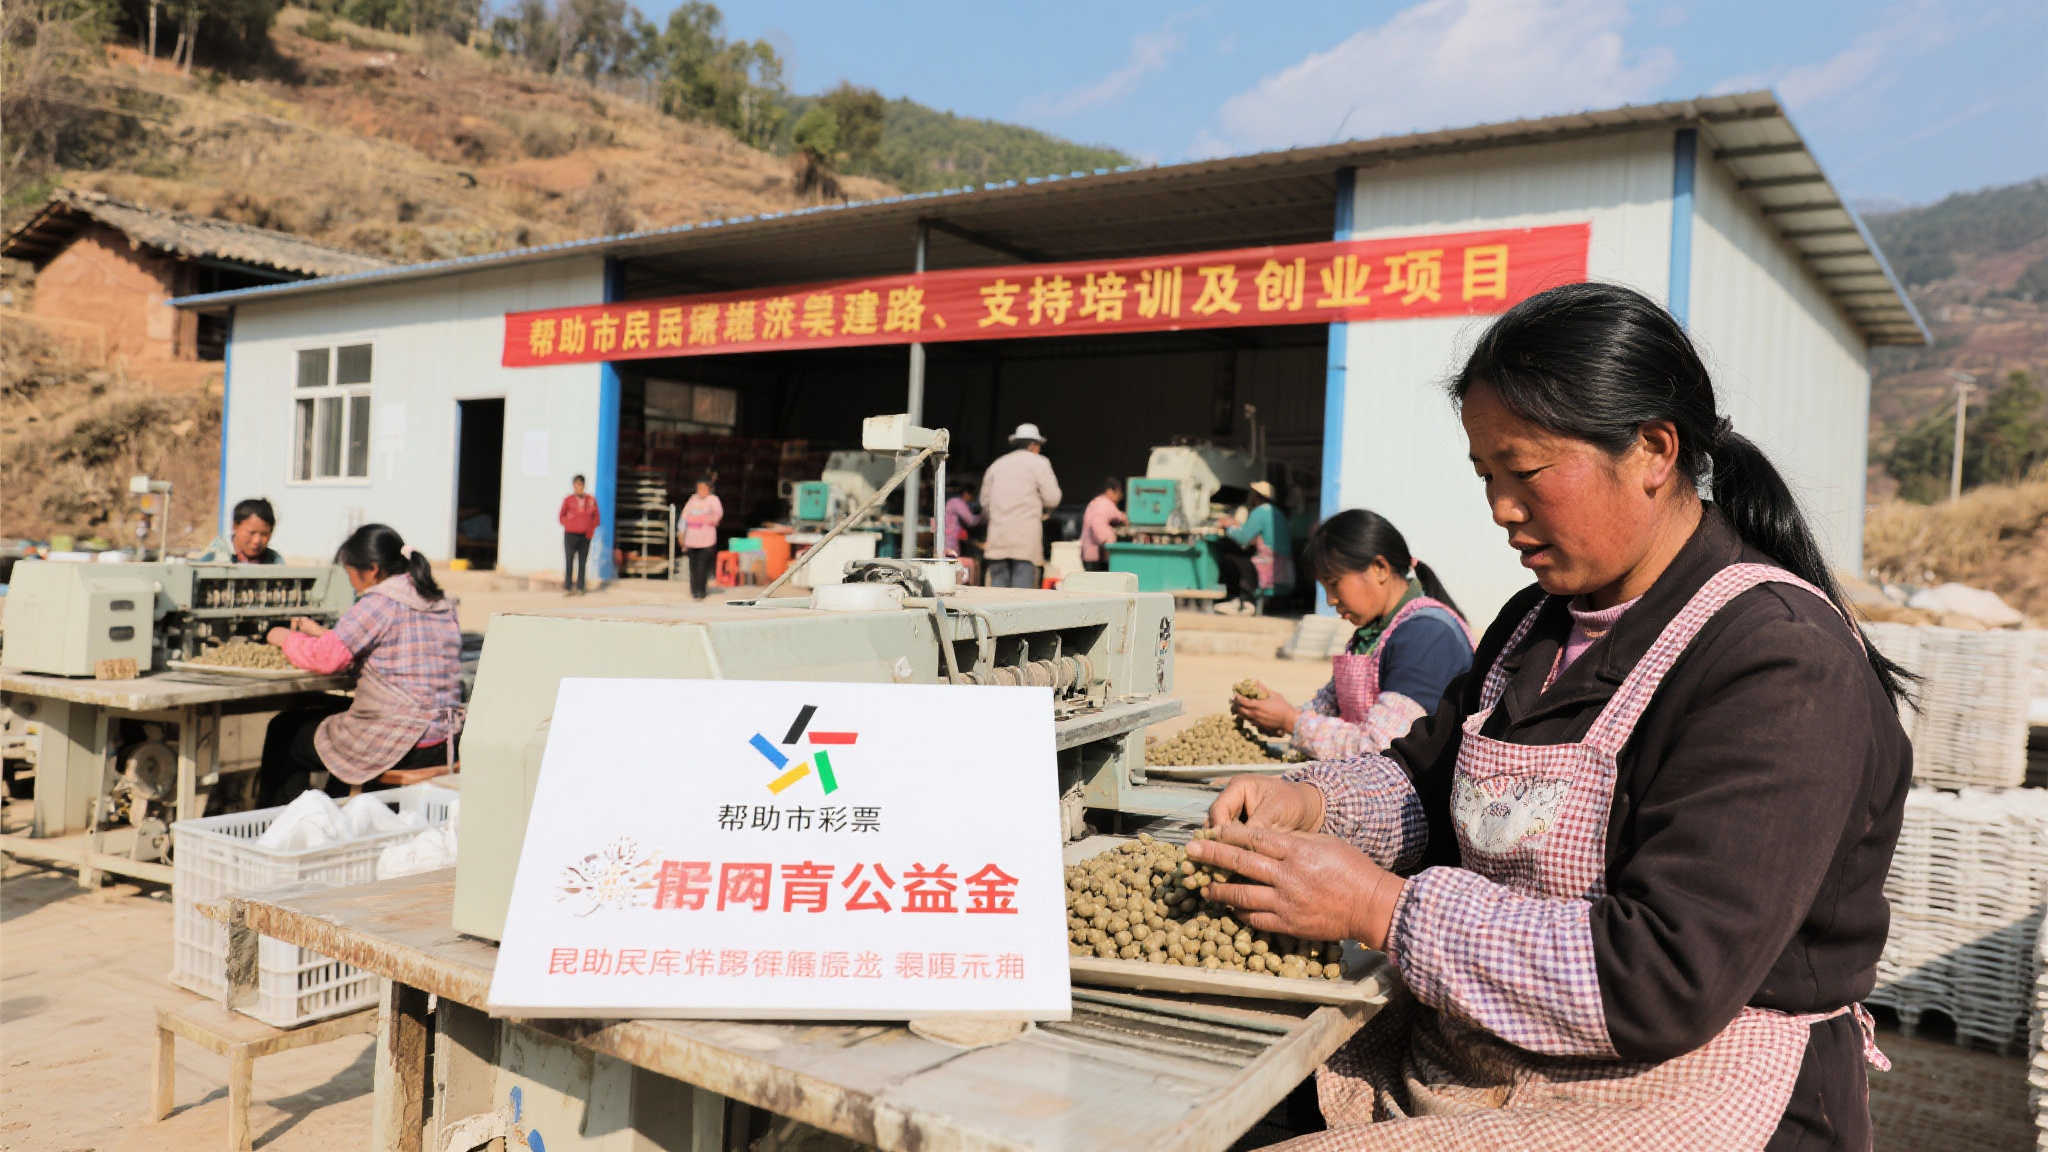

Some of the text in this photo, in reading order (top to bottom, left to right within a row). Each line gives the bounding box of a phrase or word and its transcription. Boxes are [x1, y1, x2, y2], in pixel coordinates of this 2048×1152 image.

[718, 805, 882, 833] 帮助市彩票
